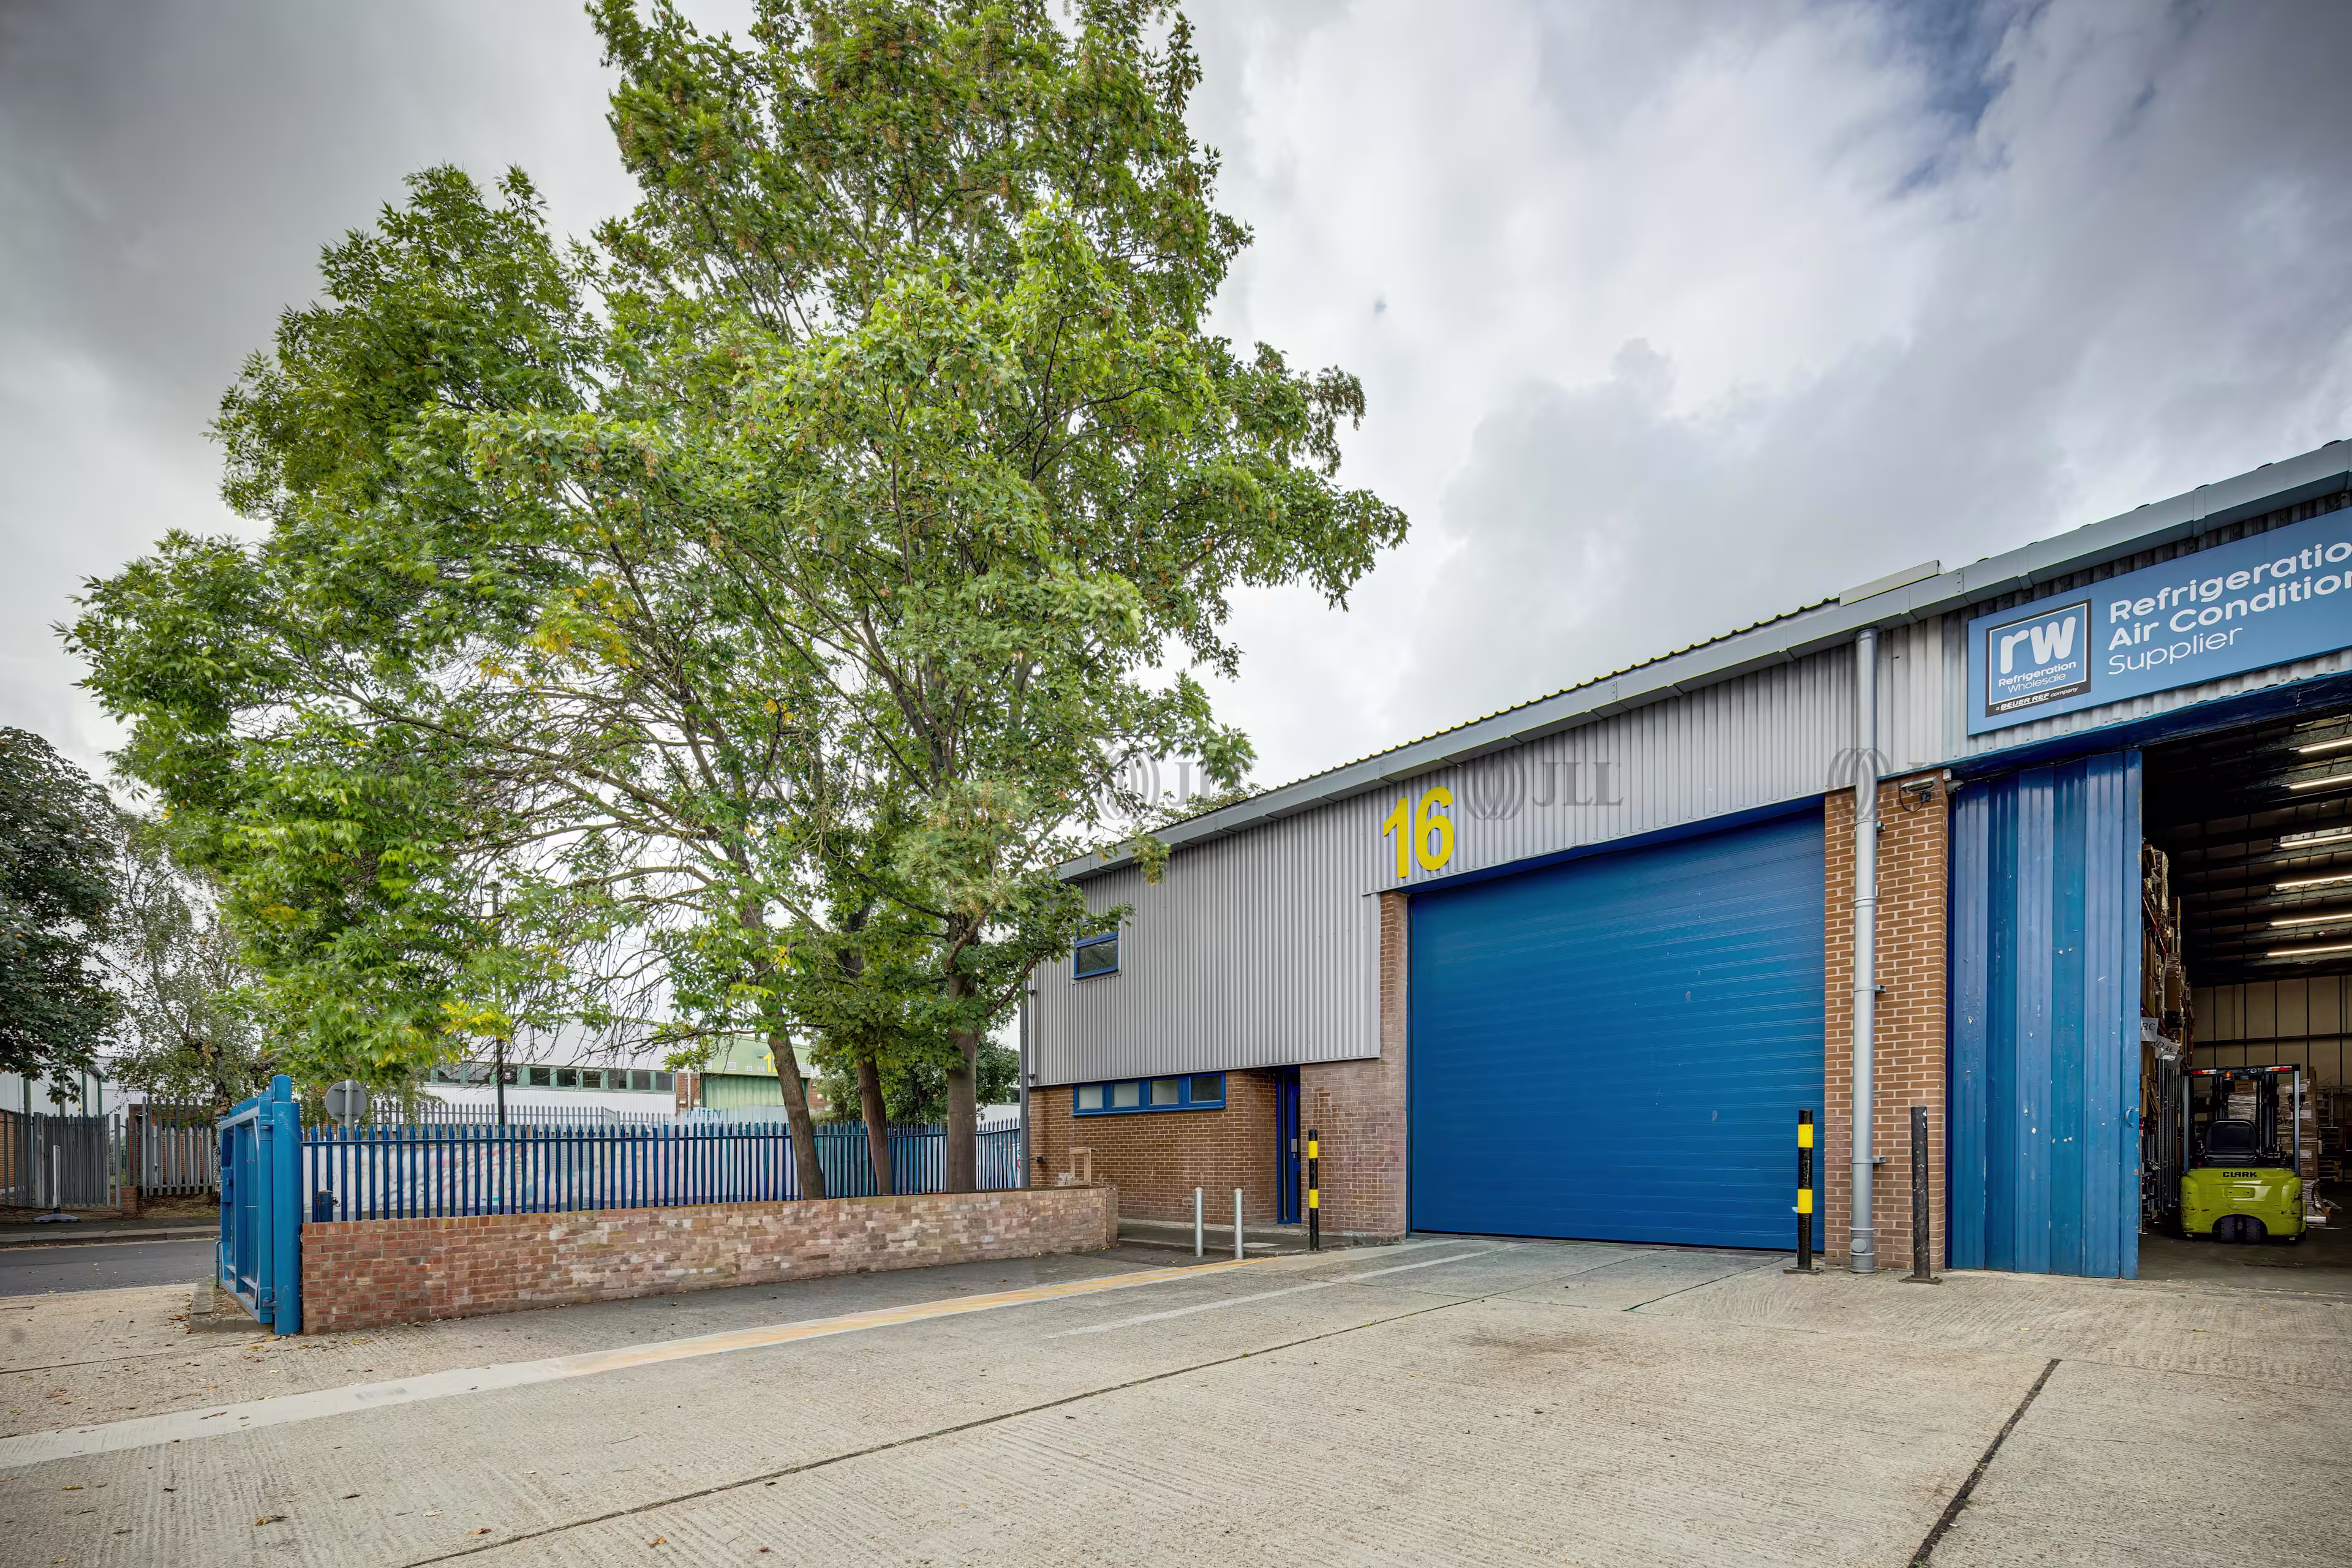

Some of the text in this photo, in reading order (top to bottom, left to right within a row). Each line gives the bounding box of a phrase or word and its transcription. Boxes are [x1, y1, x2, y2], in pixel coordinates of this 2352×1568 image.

[2110, 542, 2352, 624] Refrigeratio
[2000, 616, 2076, 674] rw
[2108, 622, 2160, 650] Air
[2108, 627, 2243, 674] Supplier
[1999, 662, 2076, 687] Refrigeration
[2008, 673, 2067, 693] Wholesale
[2032, 692, 2051, 702] REF
[2050, 687, 2079, 698] company
[1383, 786, 1455, 878] 16
